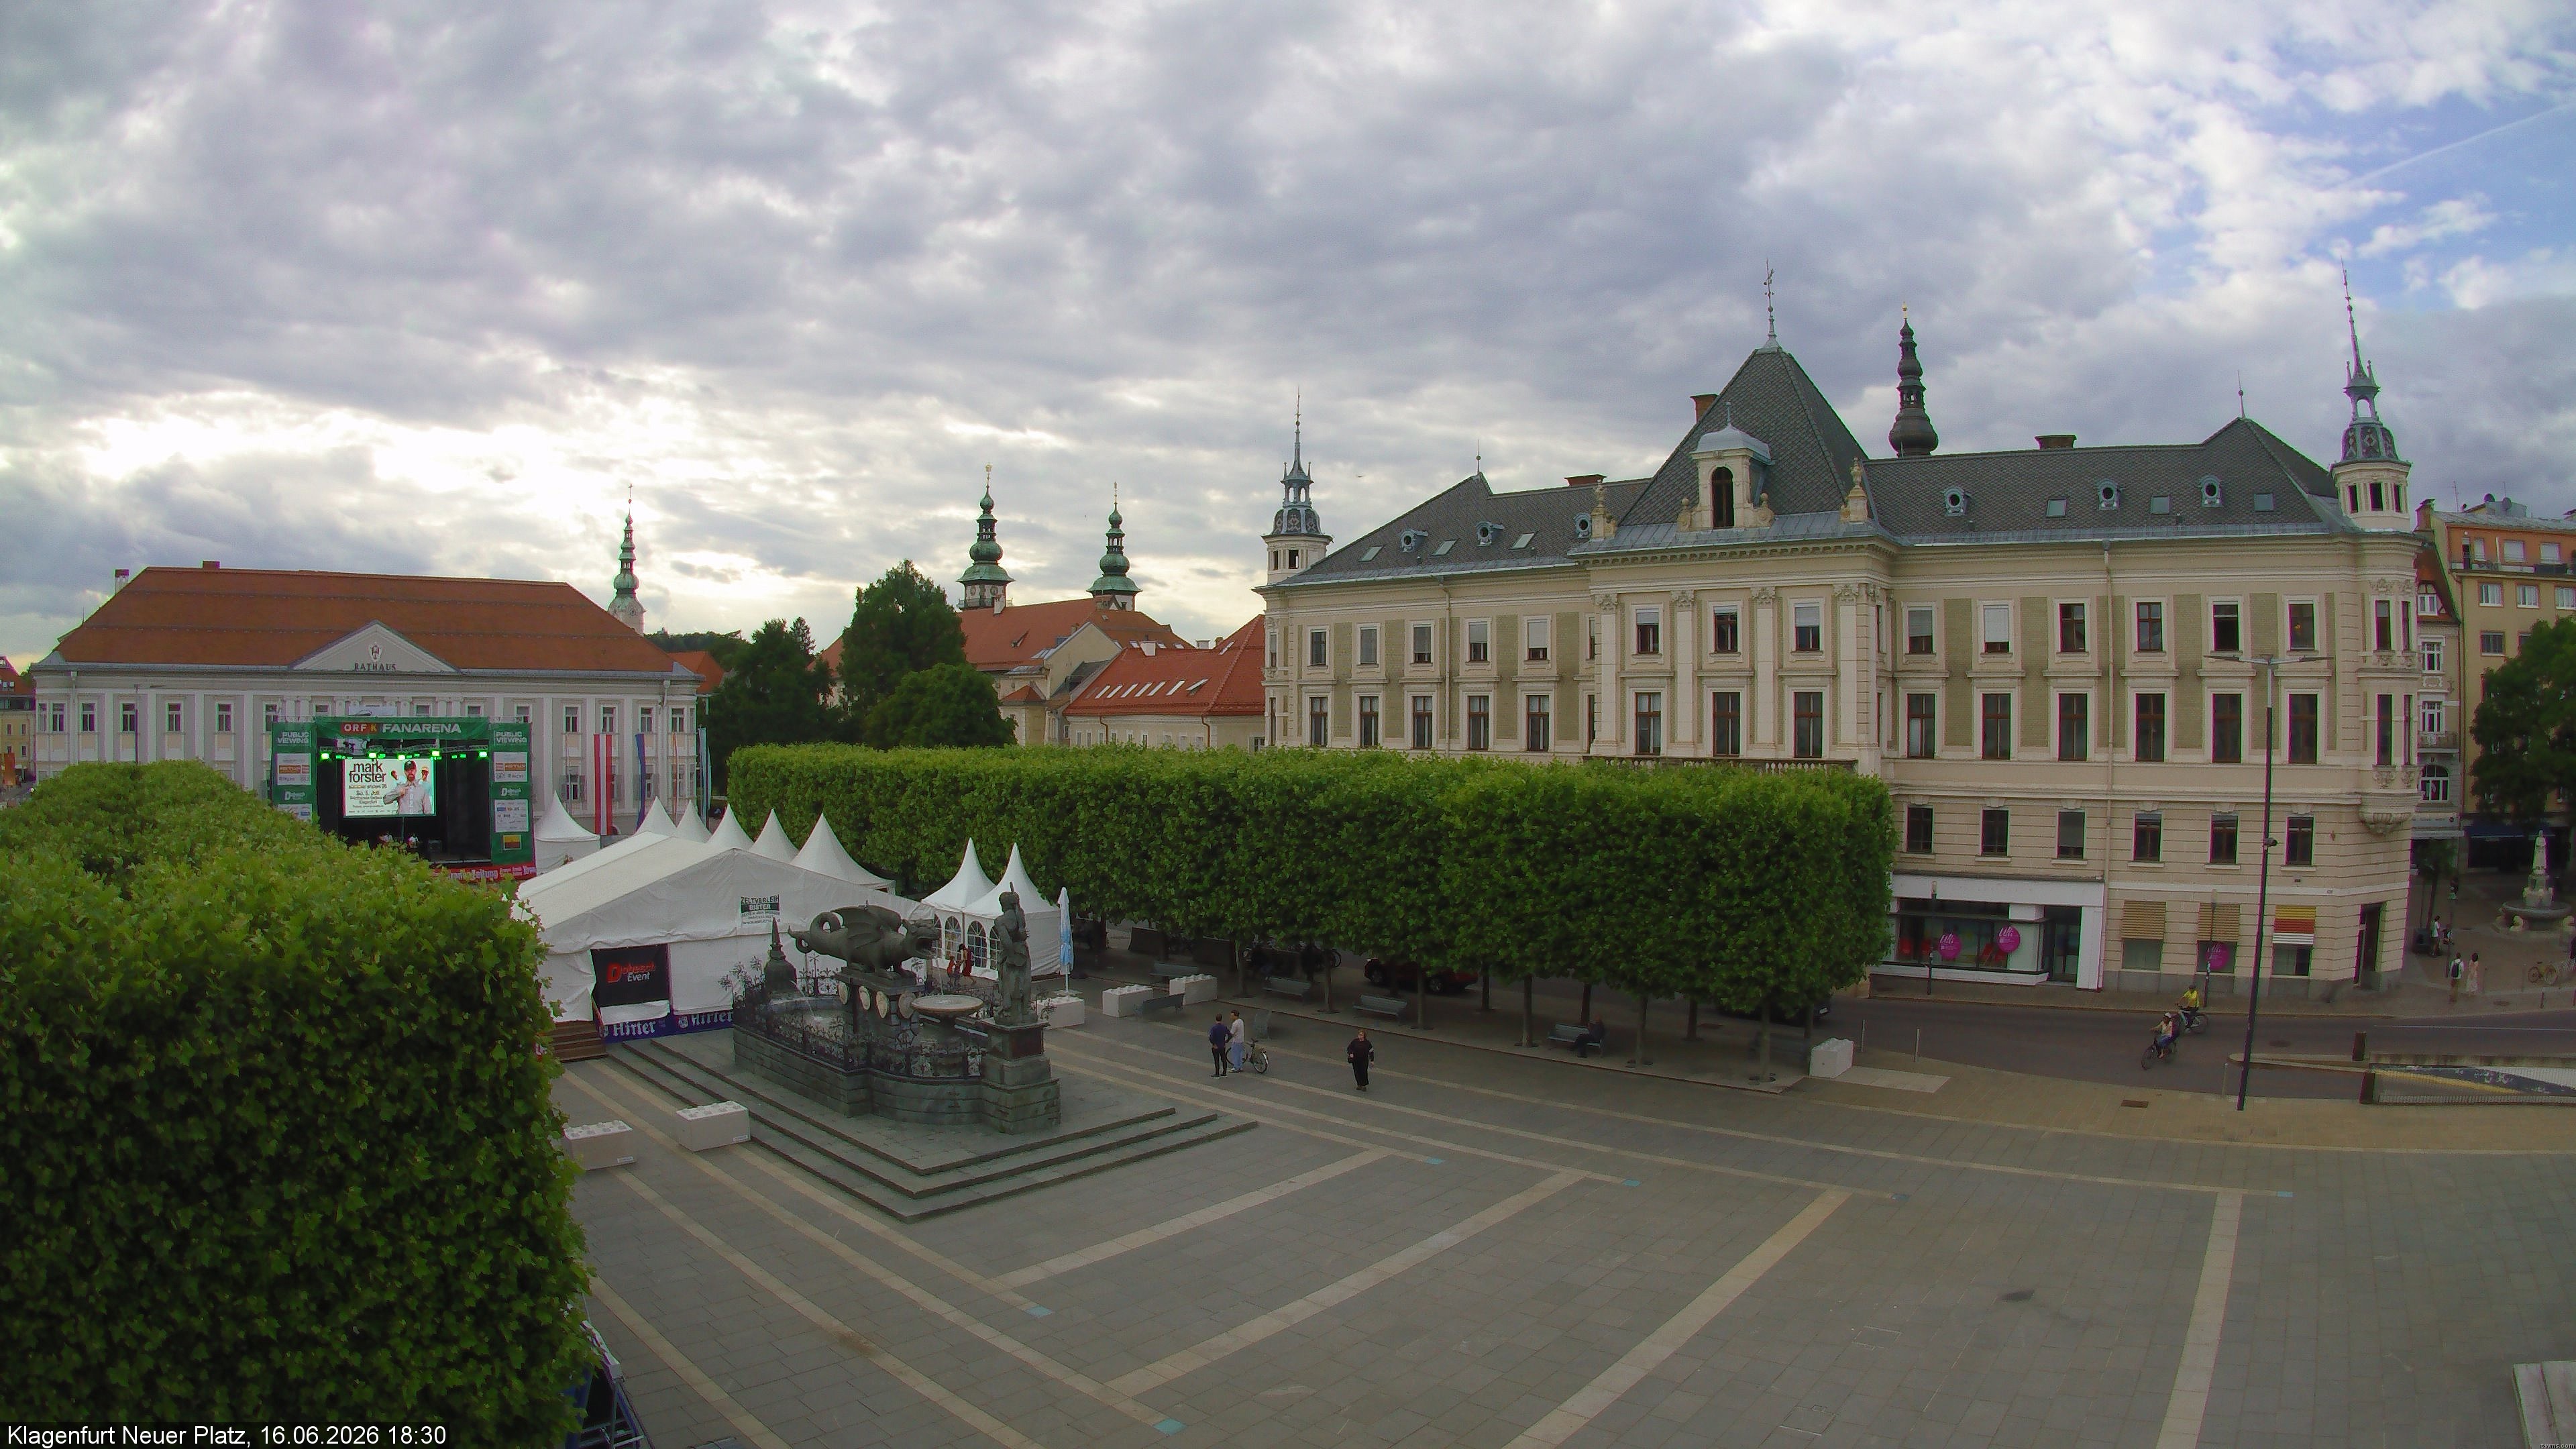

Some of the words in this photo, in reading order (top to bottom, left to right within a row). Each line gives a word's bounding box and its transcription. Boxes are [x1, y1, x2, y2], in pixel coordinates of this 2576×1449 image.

[354, 663, 397, 672] RATHAUS
[343, 723, 367, 732] ORF
[382, 723, 462, 733] FANARENA
[352, 759, 383, 772] mark
[348, 771, 387, 783] forster
[741, 894, 780, 904] ZELTVERLEIH
[627, 971, 651, 982] Event
[692, 1011, 734, 1026] Hirter
[613, 1020, 656, 1036] Hirter
